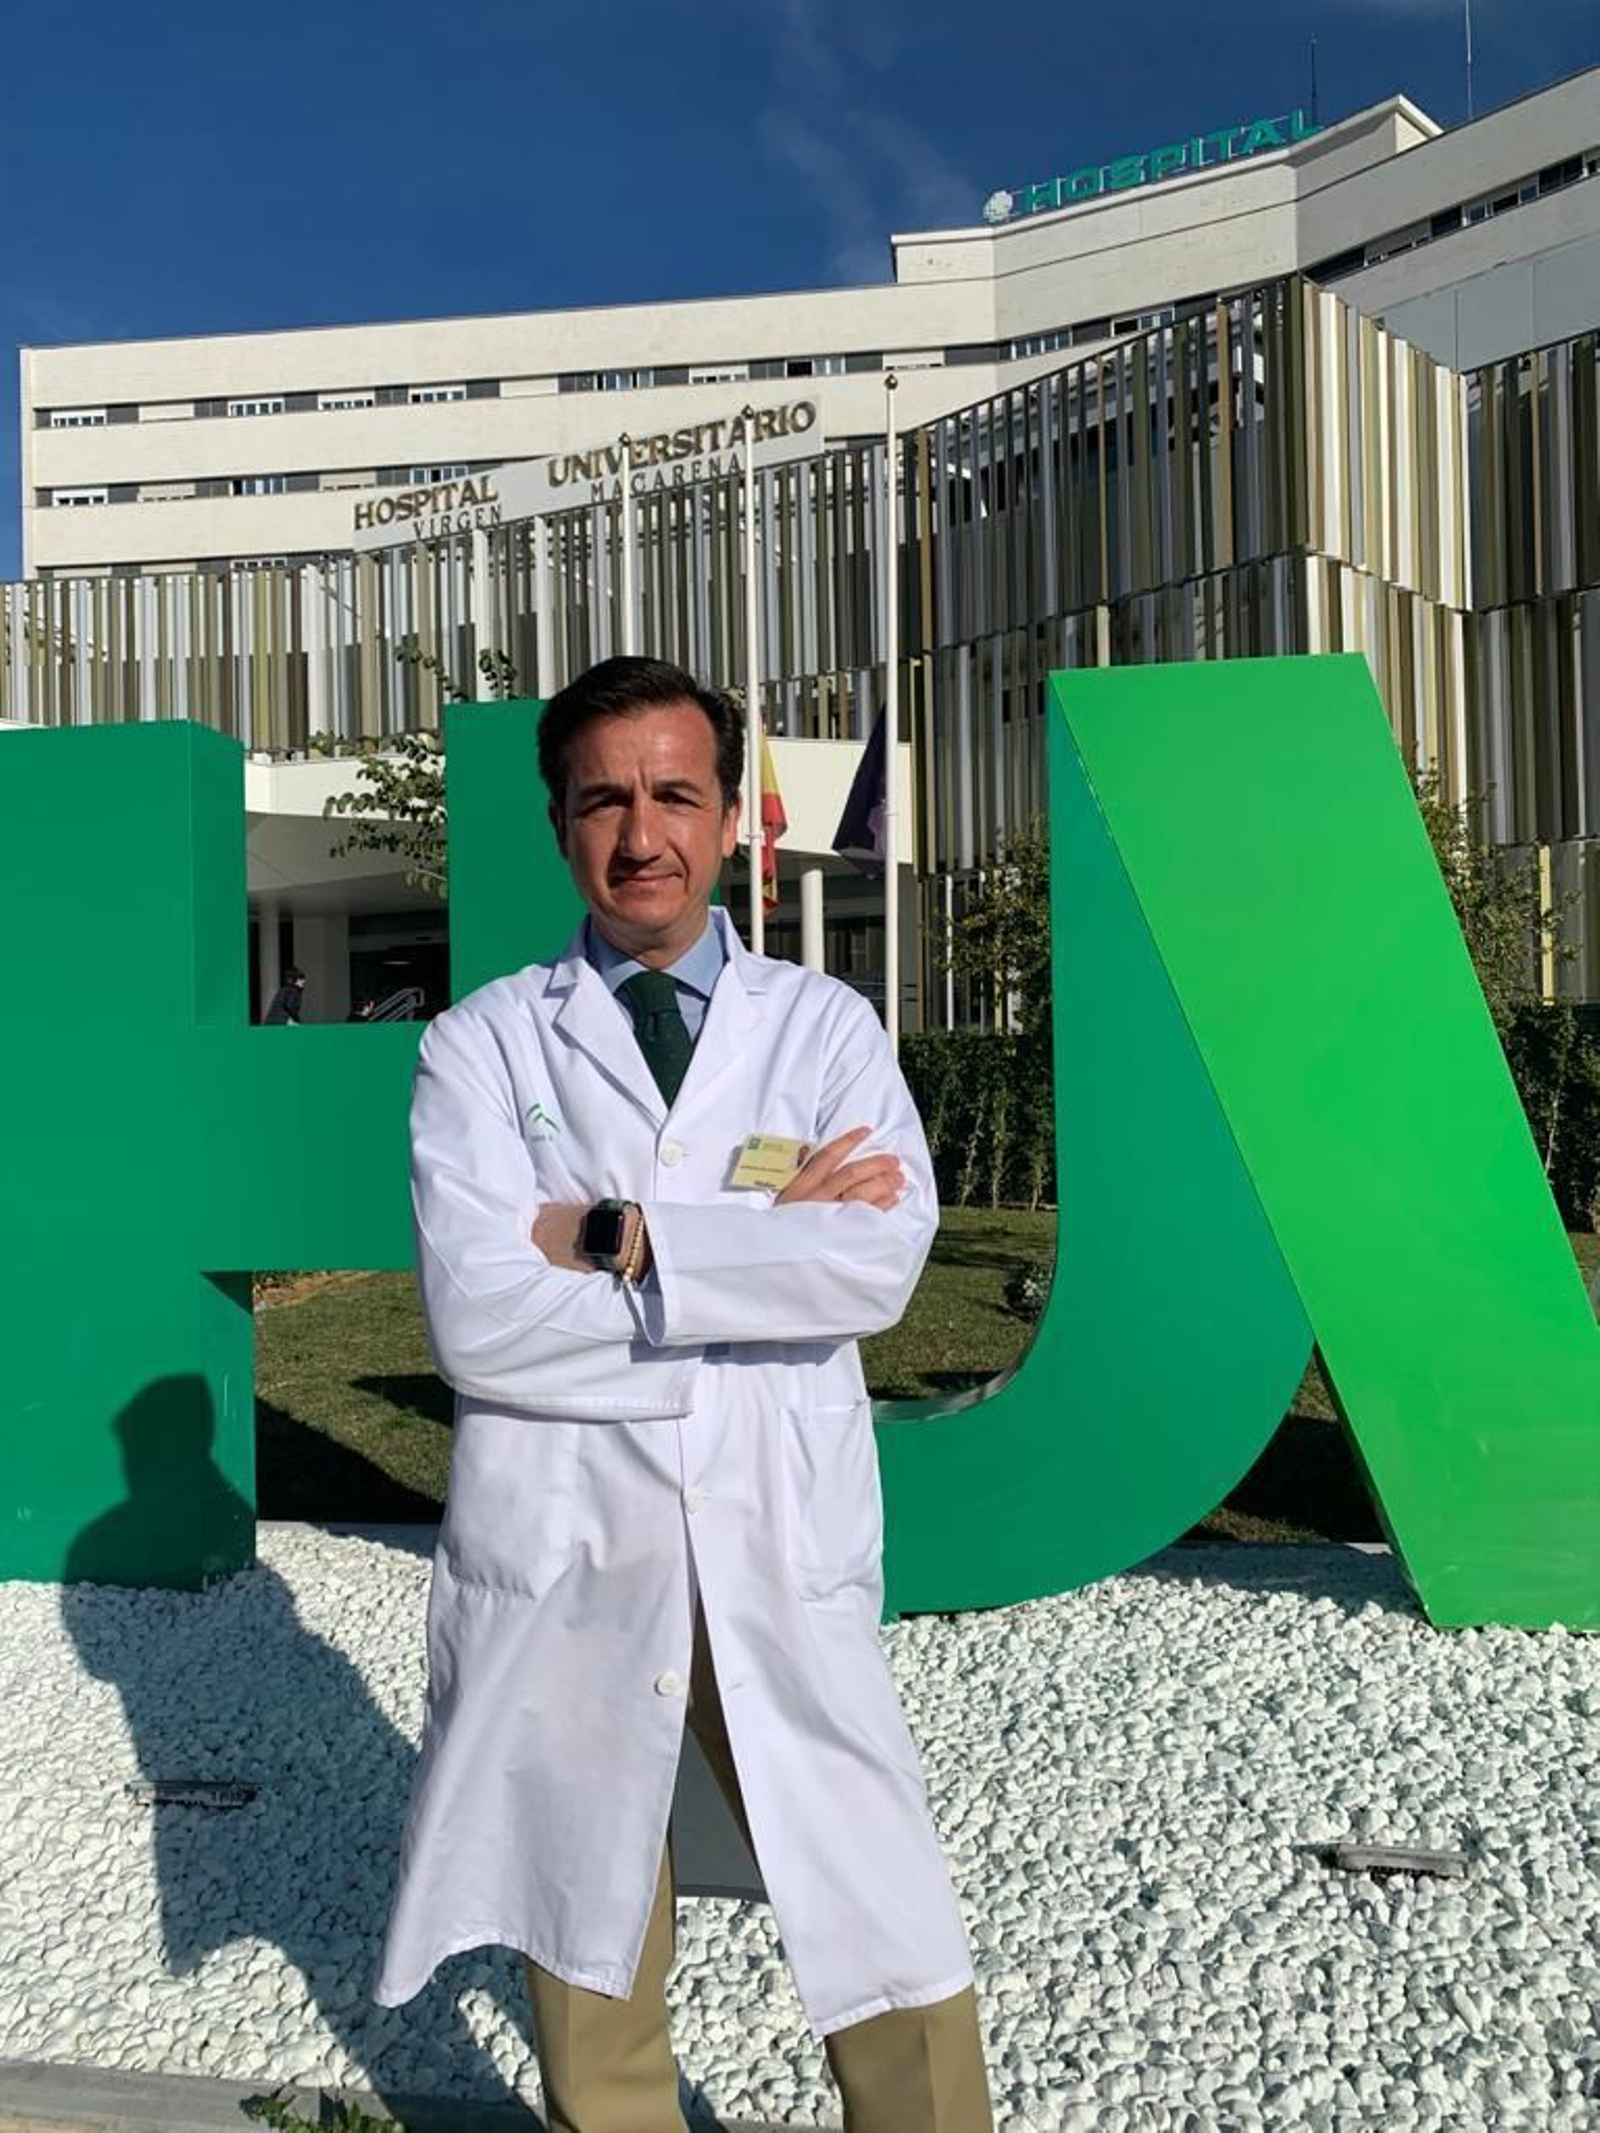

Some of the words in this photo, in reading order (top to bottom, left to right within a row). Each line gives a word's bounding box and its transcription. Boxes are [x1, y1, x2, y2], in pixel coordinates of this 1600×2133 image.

[1024, 107, 1325, 215] HOSPITAL
[354, 474, 498, 531] HOSPITAL
[548, 400, 817, 488] UNIVERSITARIO
[413, 502, 501, 540] VIRGEN
[590, 452, 742, 503] MACARENA
